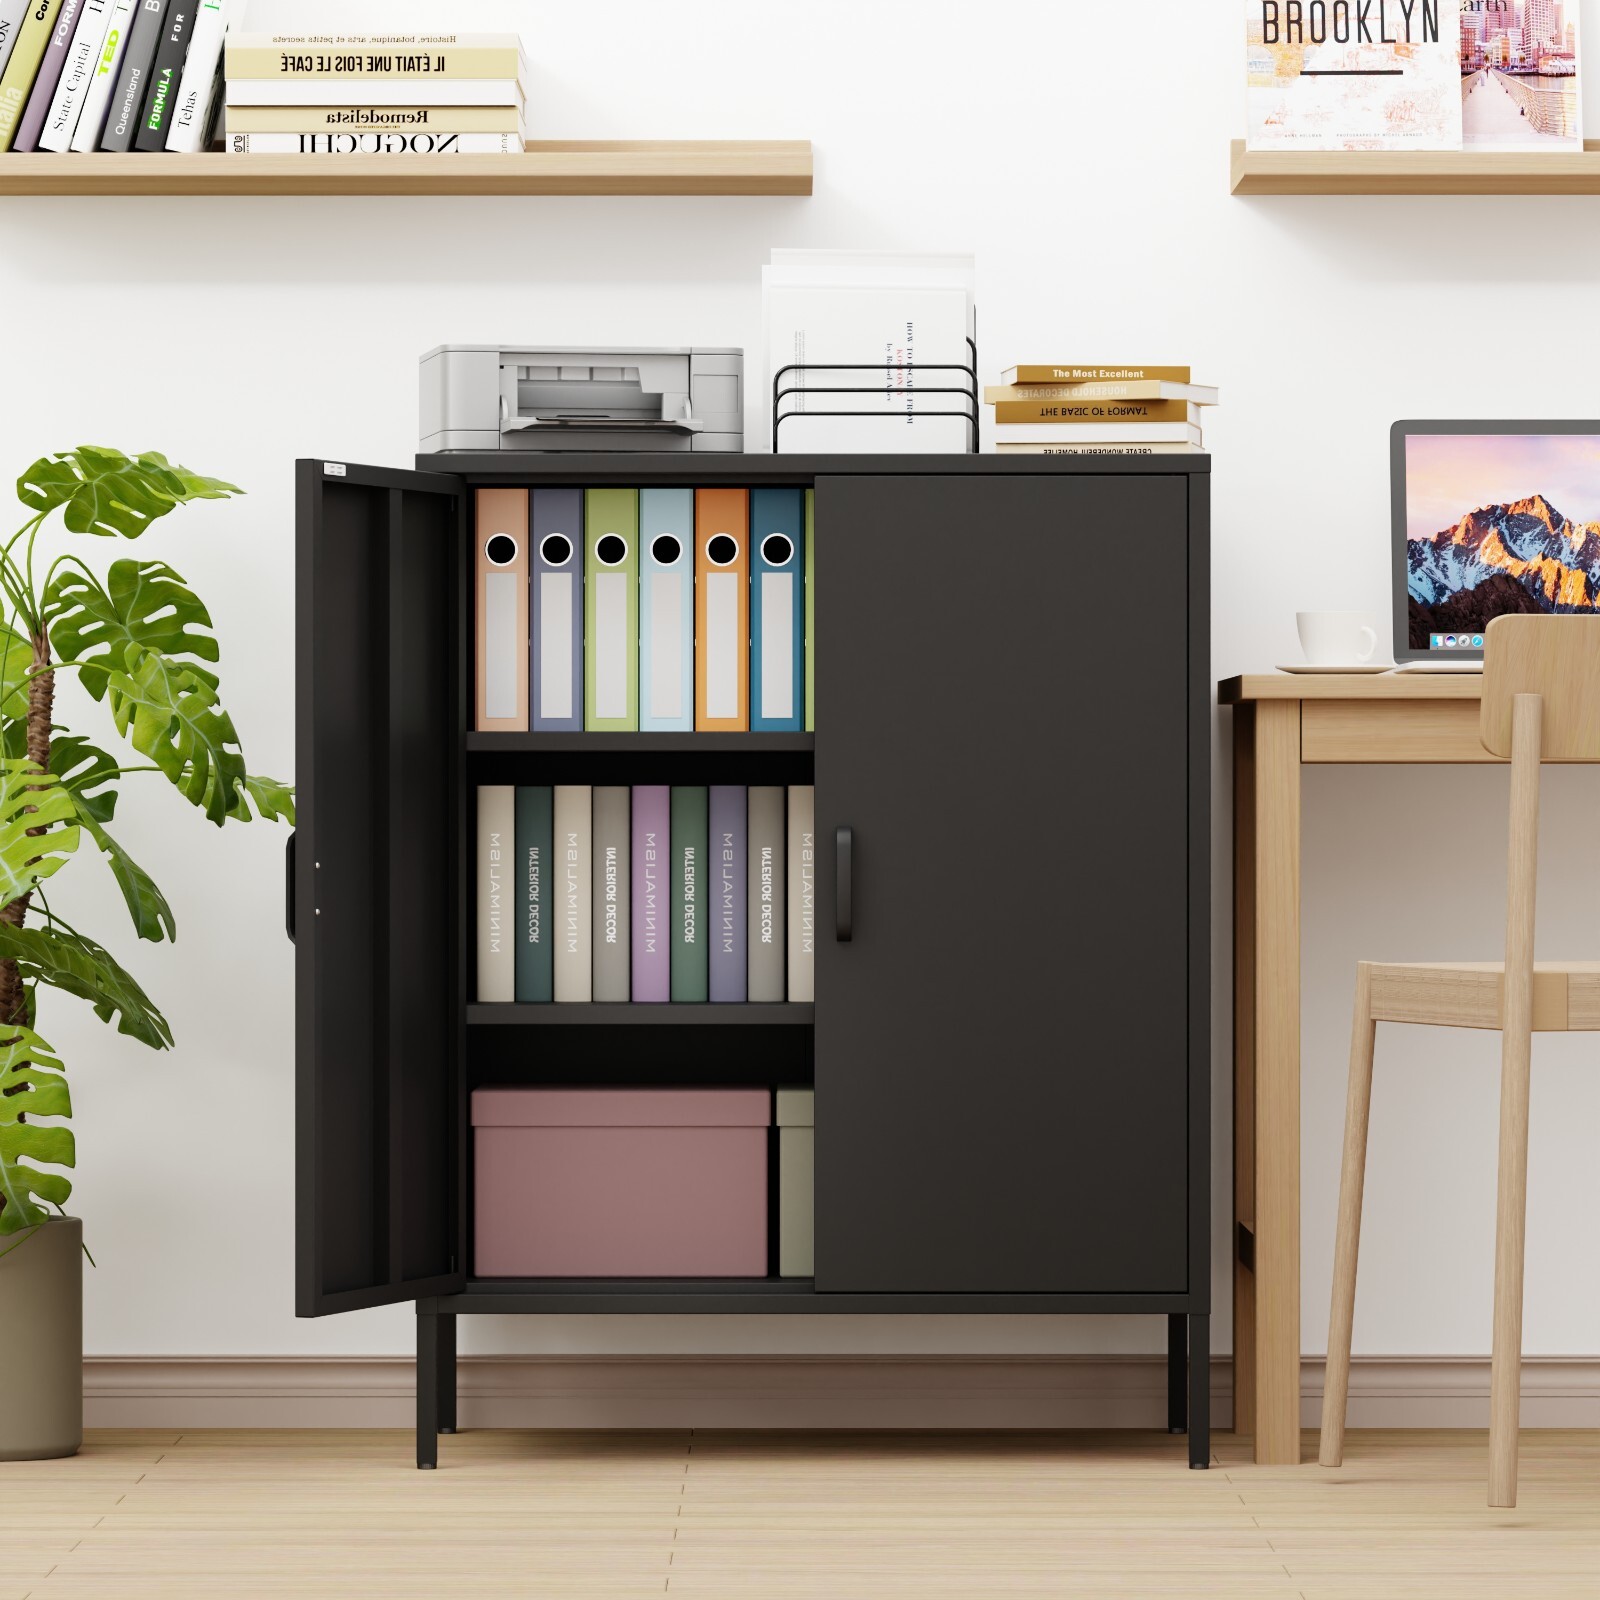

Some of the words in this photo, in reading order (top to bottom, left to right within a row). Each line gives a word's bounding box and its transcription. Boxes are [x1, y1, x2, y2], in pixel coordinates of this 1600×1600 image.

[170, 13, 185, 43] FOR
[1262, 0, 1439, 44] BROOKLYN
[97, 29, 120, 77] TED
[53, 95, 74, 132] State
[66, 42, 91, 92] Capital
[115, 68, 141, 135] Queensland
[148, 68, 173, 131] FORMULA
[177, 90, 198, 128] Tehas
[1053, 369, 1070, 378] The
[1072, 370, 1097, 378] Most
[1099, 370, 1144, 379] Excellent
